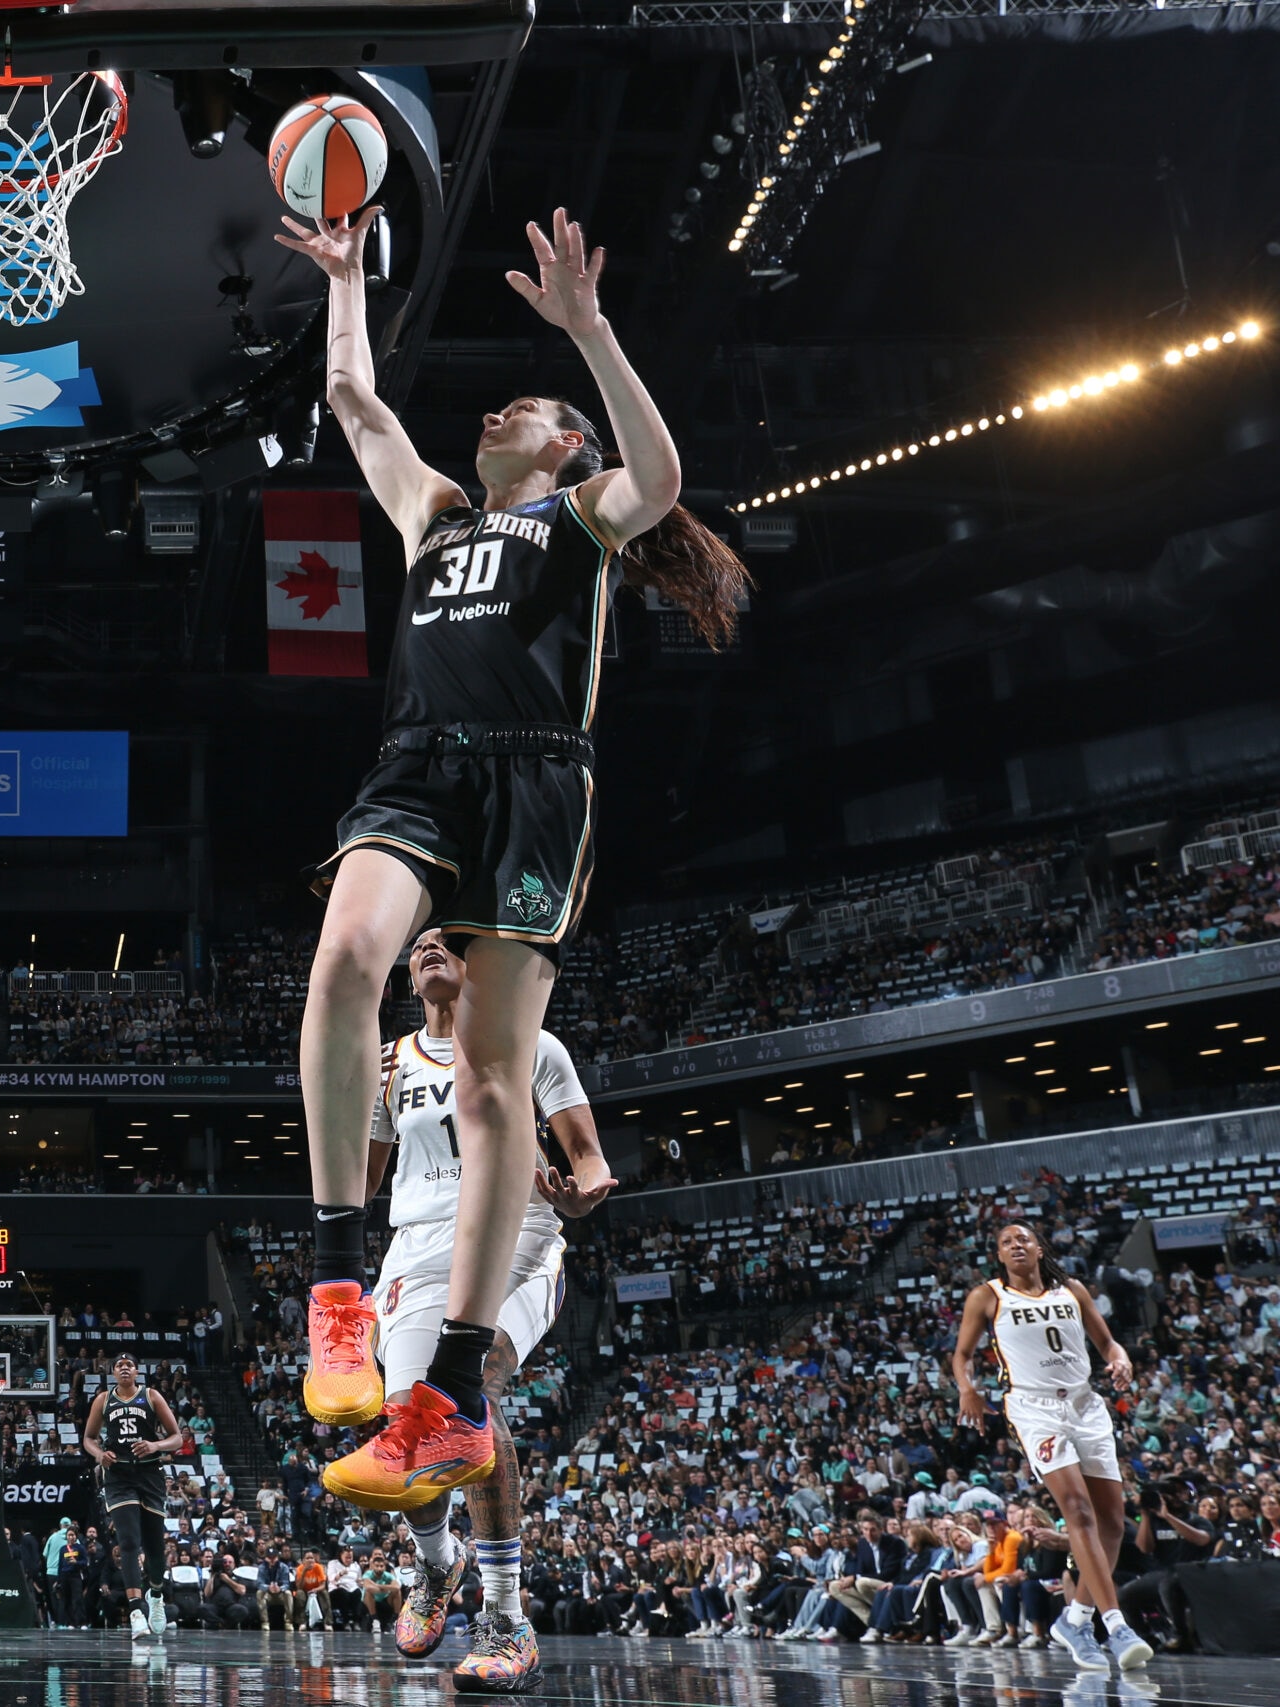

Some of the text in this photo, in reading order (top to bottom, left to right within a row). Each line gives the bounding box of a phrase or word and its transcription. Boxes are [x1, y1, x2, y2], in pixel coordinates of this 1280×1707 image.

[412, 512, 552, 568] NEW YORK
[428, 539, 504, 597] 30
[449, 602, 510, 622] webull
[31, 756, 90, 770] Official
[1024, 985, 1056, 1001] 7:48
[1104, 975, 1121, 998] 8
[970, 1001, 987, 1021] 9
[636, 1058, 654, 1070] REB
[33, 1073, 74, 1086] KYM
[78, 1073, 166, 1086] HAMPTON
[604, 1077, 611, 1088] 3
[398, 1081, 455, 1114] FEV
[1011, 1304, 1077, 1326] FEVER
[1045, 1326, 1063, 1353] 0
[109, 1407, 147, 1422] NEW YORK
[119, 1417, 138, 1435] 35
